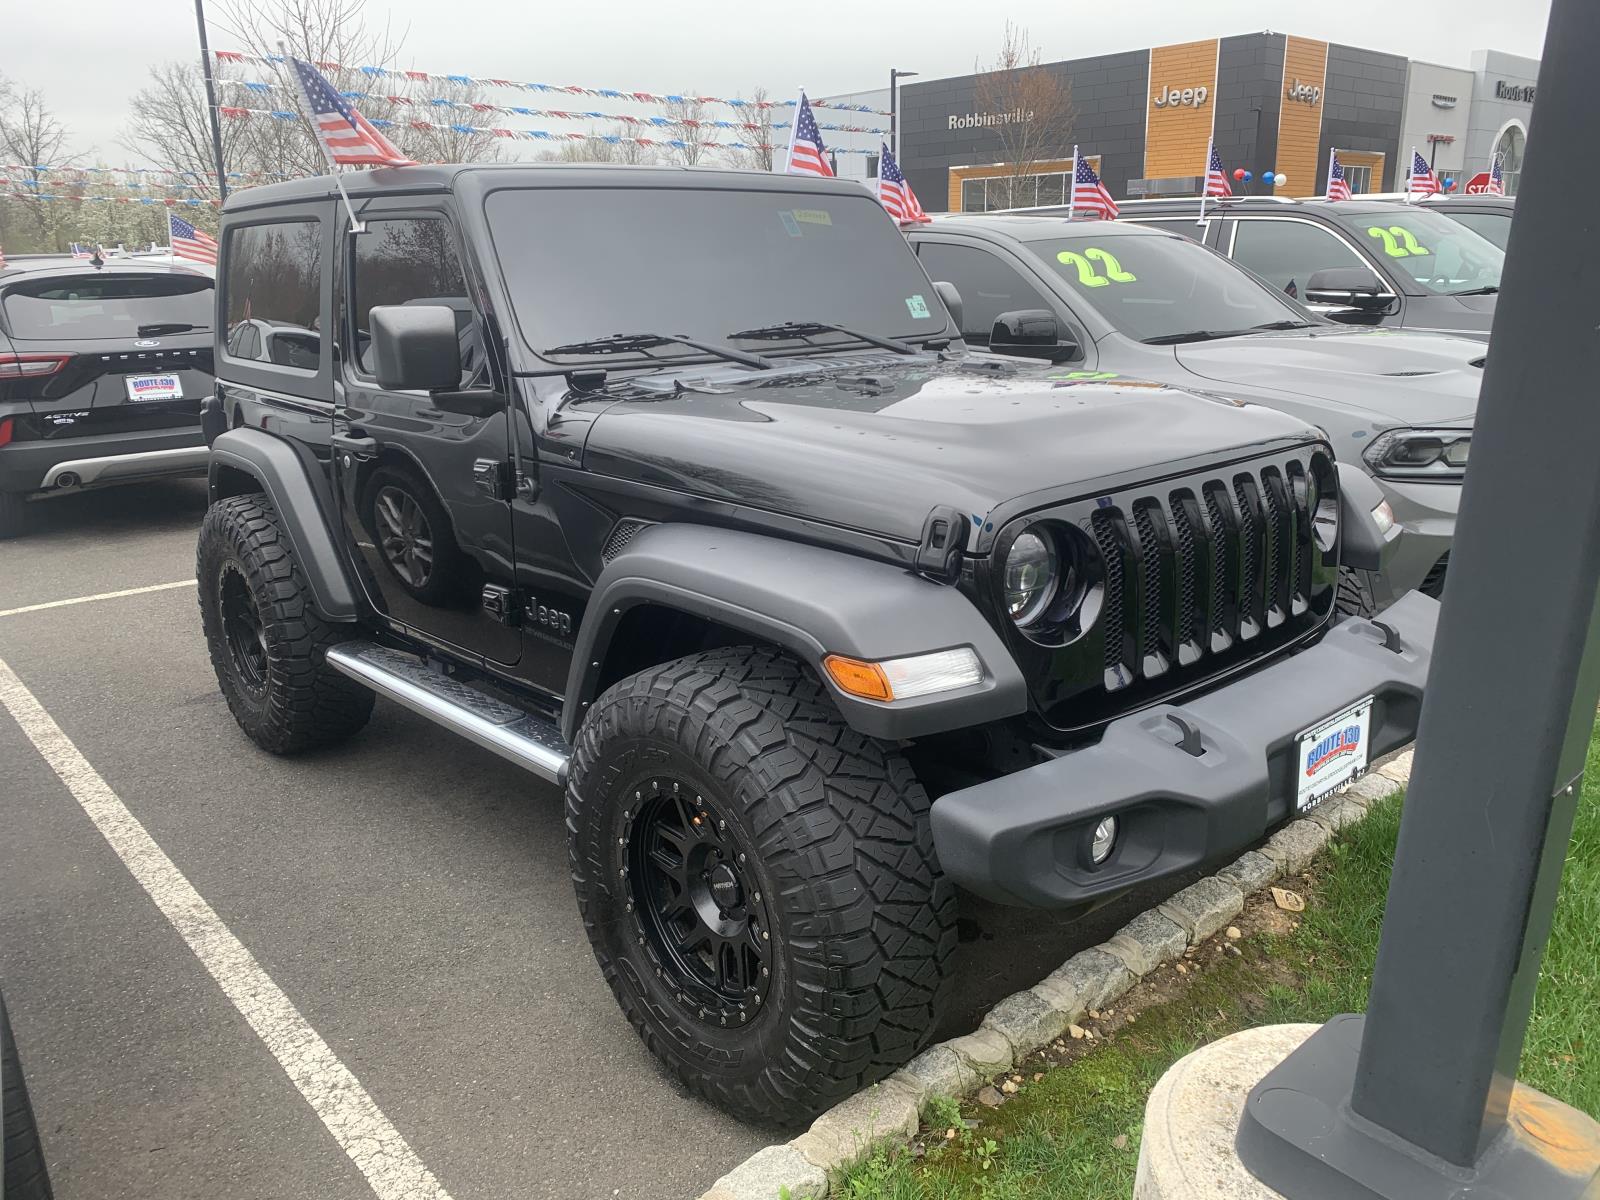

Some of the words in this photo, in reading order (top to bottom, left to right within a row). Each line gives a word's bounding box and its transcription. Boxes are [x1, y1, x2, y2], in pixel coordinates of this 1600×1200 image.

[1154, 85, 1208, 108] Jeep
[1287, 78, 1321, 107] Jeep
[948, 107, 1034, 130] Robbinsville
[1368, 226, 1429, 257] 22
[1056, 247, 1137, 288] 22
[133, 379, 159, 389] ROUTE
[159, 378, 175, 387] 130
[44, 411, 90, 419] ACTIVE
[525, 596, 571, 636] Jeep
[1306, 729, 1343, 769] ROUTE
[1343, 725, 1361, 744] 130
